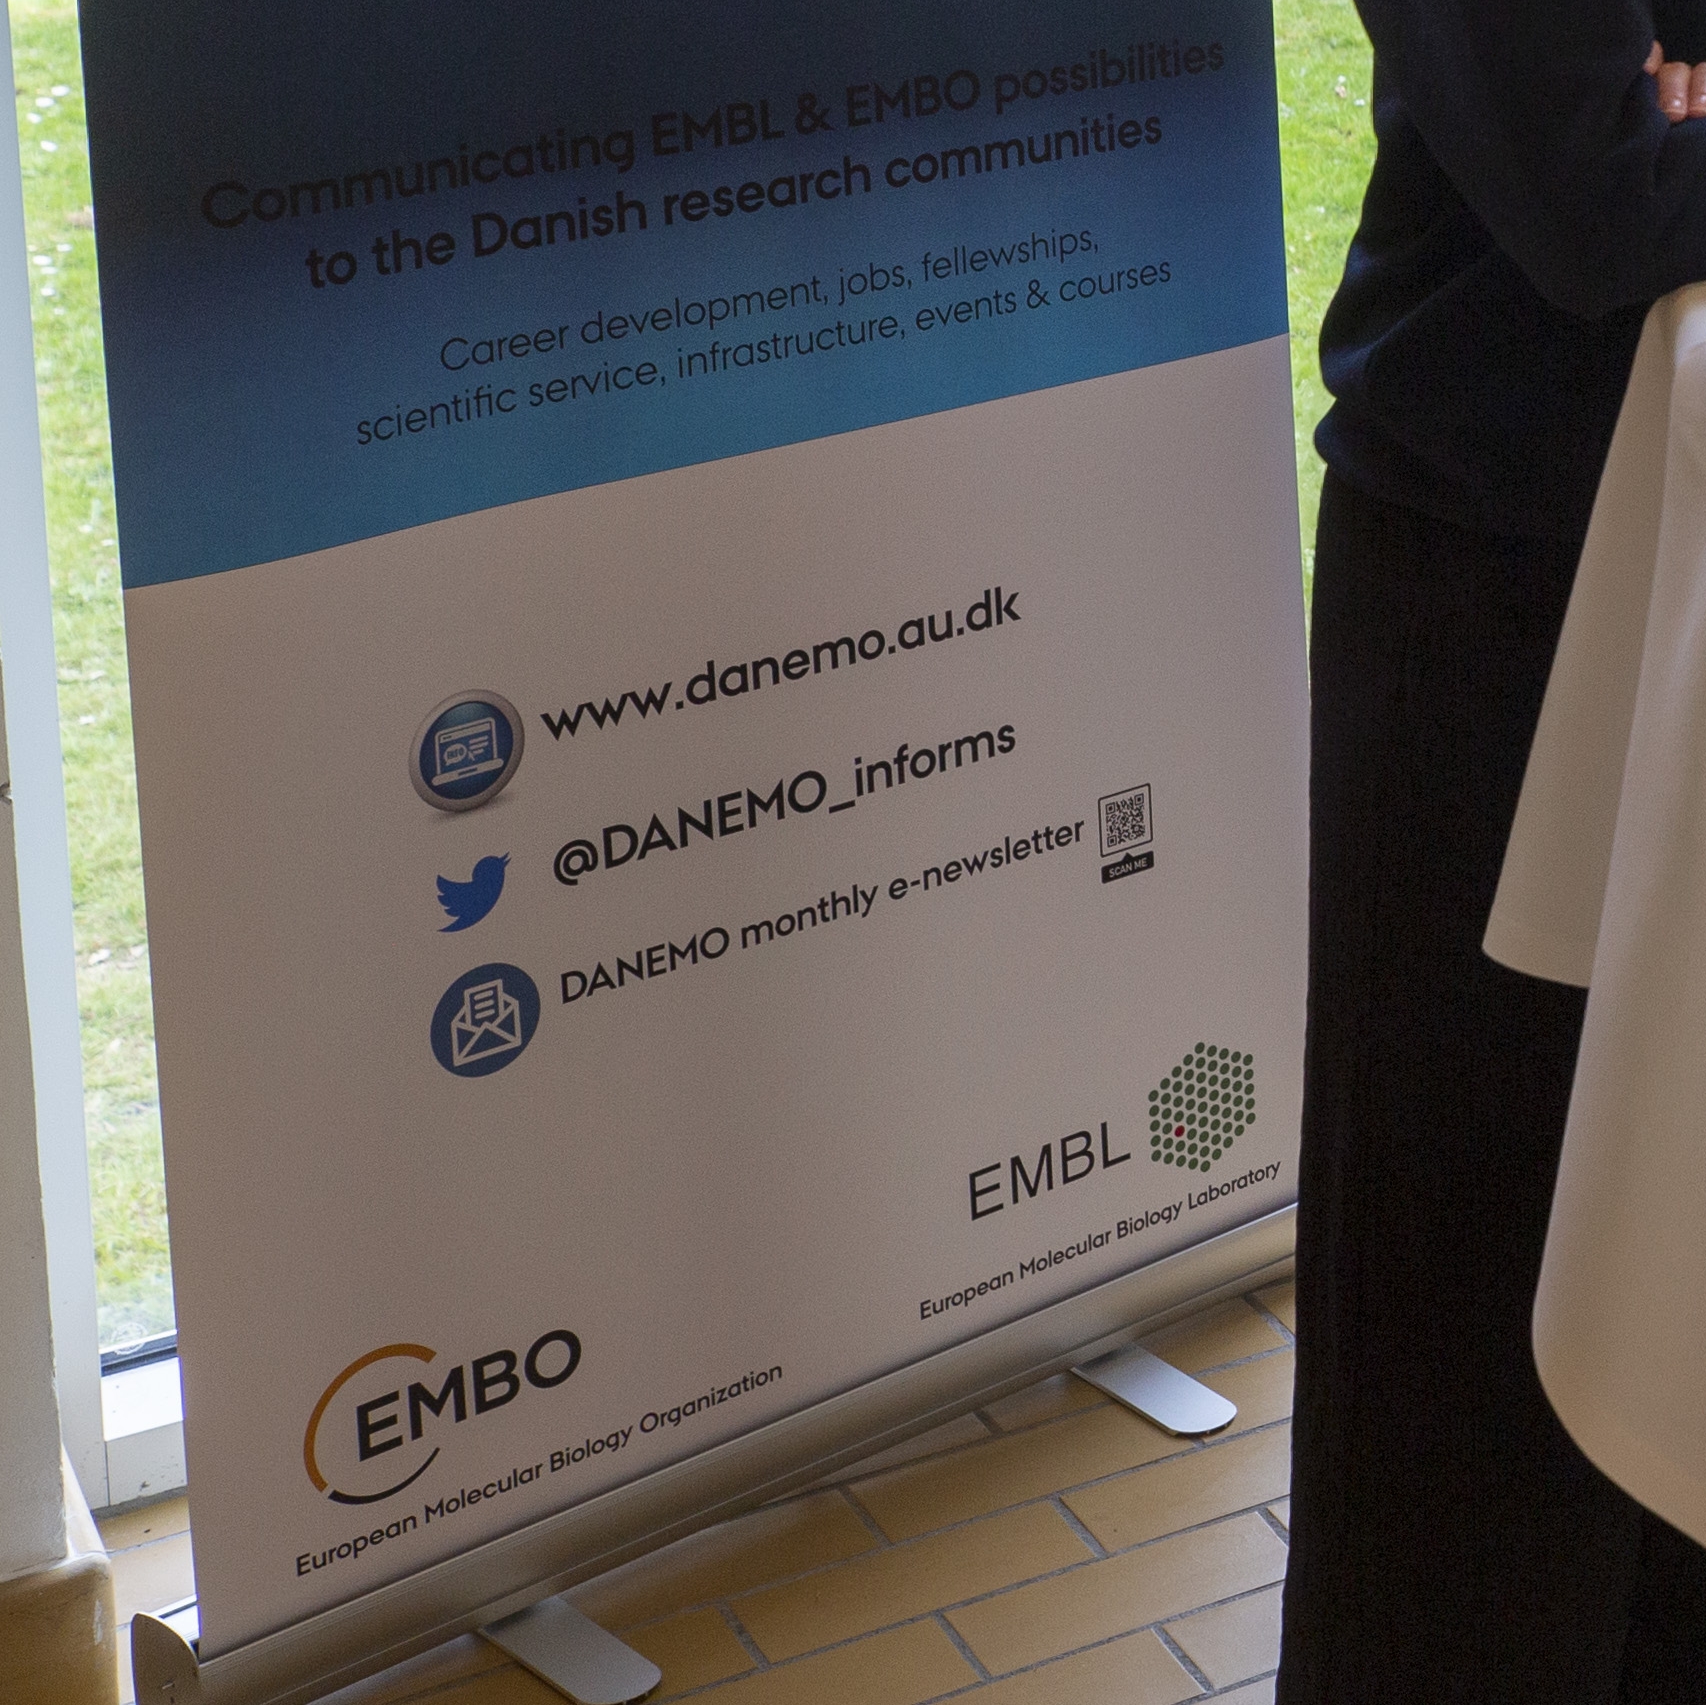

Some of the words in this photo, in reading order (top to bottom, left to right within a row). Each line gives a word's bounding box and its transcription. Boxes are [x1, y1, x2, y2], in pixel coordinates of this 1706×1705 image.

[202, 128, 636, 230] Communicating
[652, 98, 785, 158] EMBL
[795, 93, 831, 135] &
[847, 69, 981, 128] EMBO
[994, 39, 1225, 115] possibilities
[305, 246, 357, 289] to
[371, 229, 457, 276] the
[472, 191, 649, 258] Danish
[664, 156, 871, 226] research
[885, 113, 1164, 188] communities
[356, 381, 518, 445] scientific
[528, 358, 668, 408] service,
[677, 313, 907, 379] infrastructure,
[915, 289, 1018, 332] events
[1026, 279, 1052, 310] &
[1058, 259, 1171, 303] courses
[440, 325, 570, 372] Career
[581, 274, 830, 345] development,
[837, 260, 914, 306] jobs,
[540, 586, 1023, 742] www.danemo.au.dk
[551, 721, 1017, 886] @DANEMO_informs
[1109, 862, 1132, 878] SCAN
[1134, 857, 1148, 870] ME
[560, 926, 731, 1004] DANEMO
[739, 883, 879, 951] monthly
[887, 815, 1086, 902] e-newsletter
[919, 1269, 1014, 1320] European
[1019, 1227, 1112, 1280] Molecular
[1116, 1200, 1183, 1240] Biology
[1187, 1161, 1282, 1210] Laboratory
[968, 1121, 1132, 1222] EMBL
[295, 1513, 418, 1578] European
[424, 1460, 543, 1525] Molecular
[549, 1426, 635, 1474] Biology
[639, 1363, 784, 1435] Organization
[356, 1329, 582, 1463] EMBO
